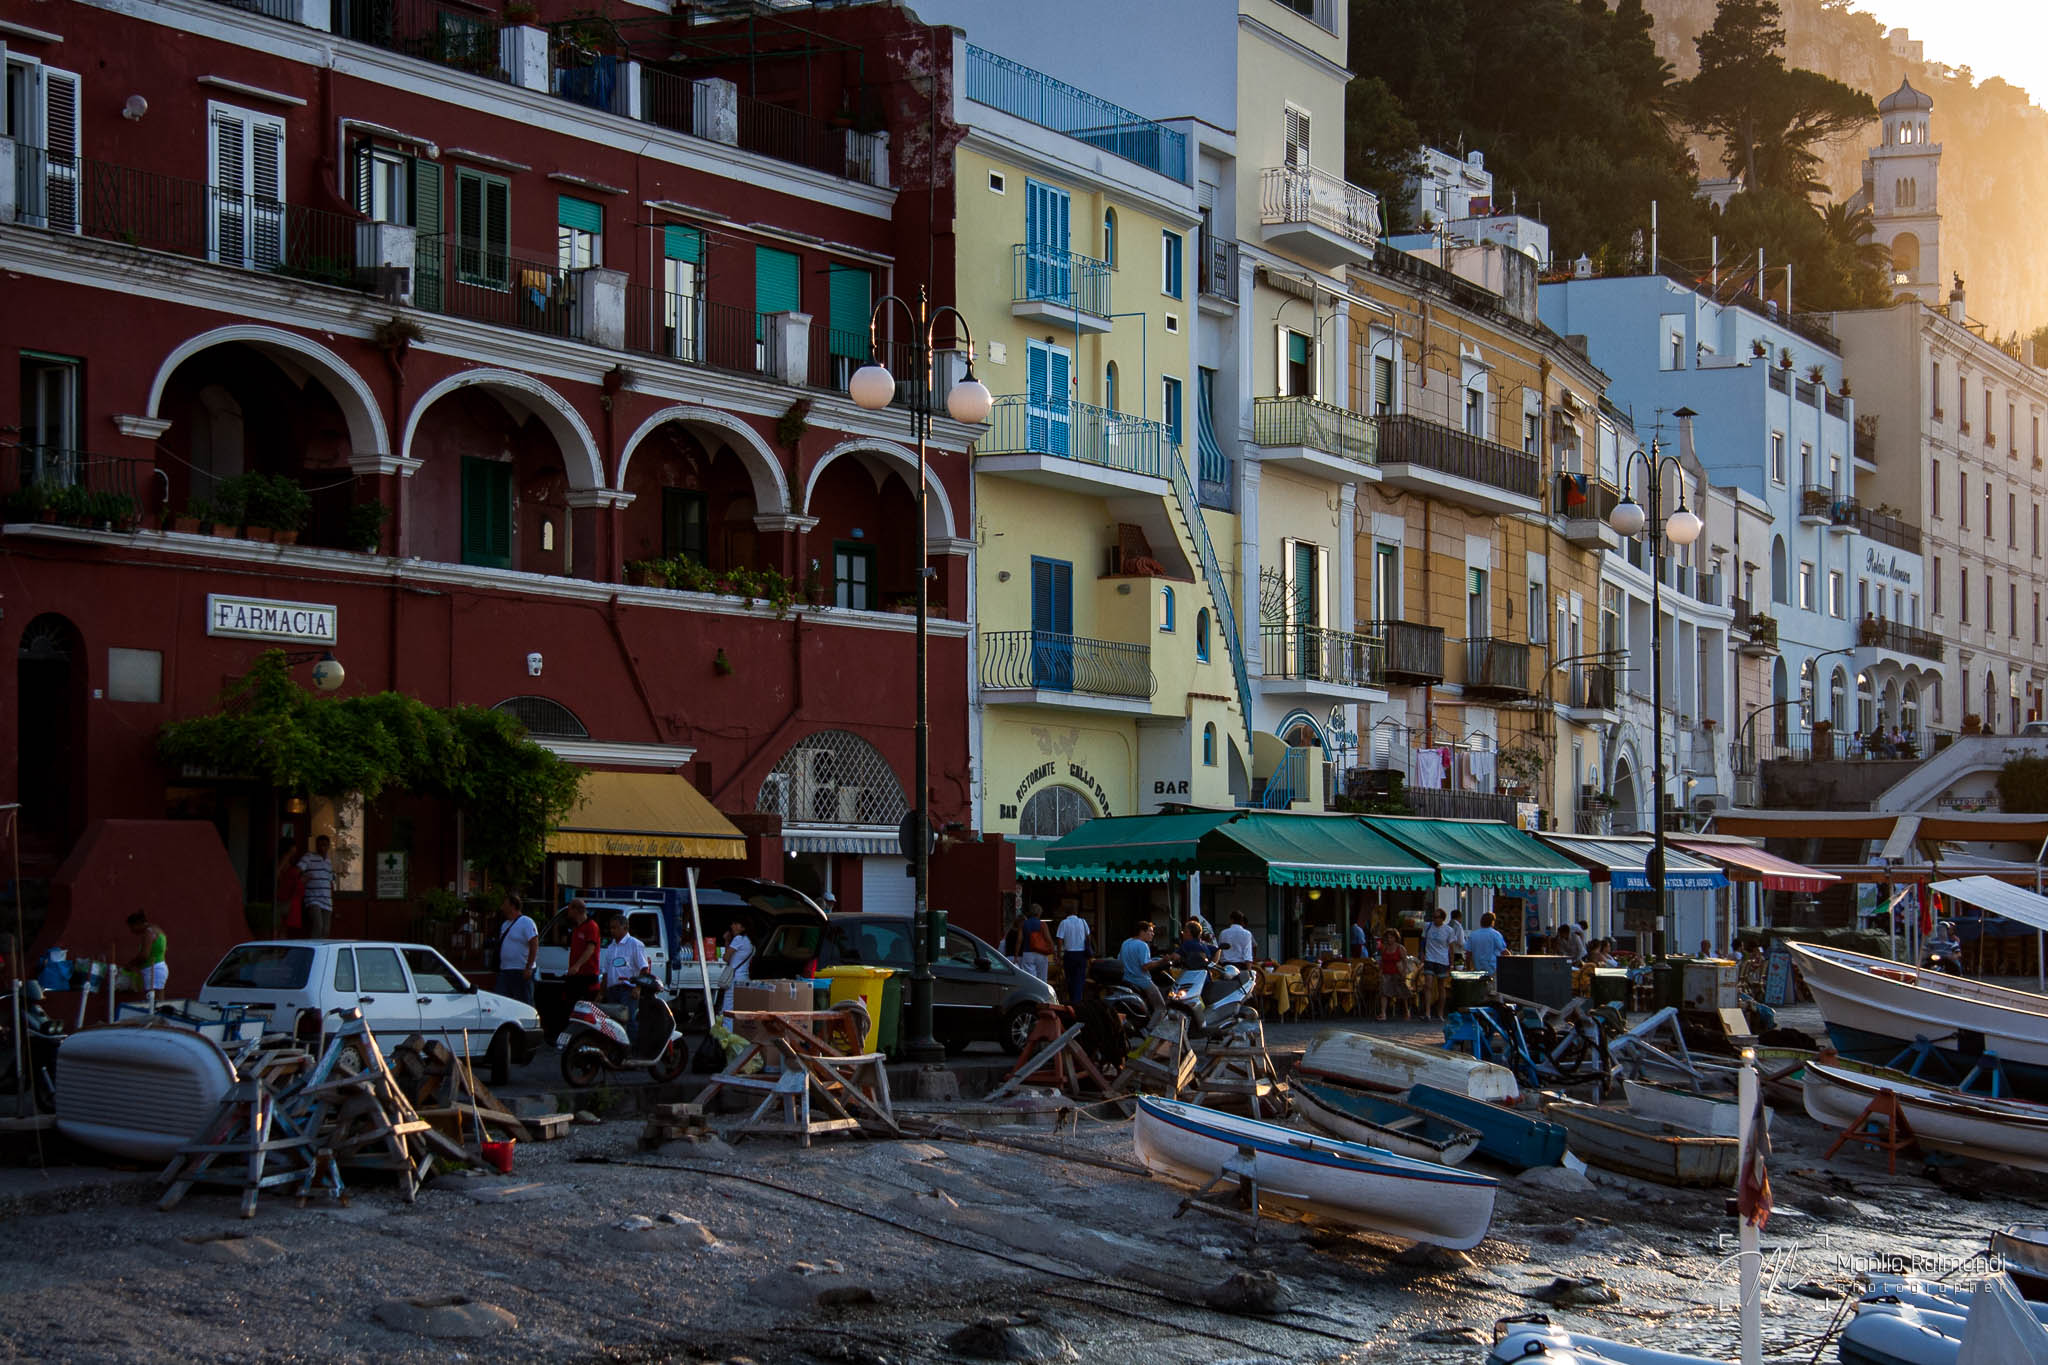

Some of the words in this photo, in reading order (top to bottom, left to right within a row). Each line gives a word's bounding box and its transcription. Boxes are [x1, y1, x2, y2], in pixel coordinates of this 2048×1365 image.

[219, 604, 327, 635] FARMACIA
[1000, 804, 1017, 819] BAR
[1016, 761, 1056, 803] RISTORANTE
[1154, 781, 1189, 794] BAR
[1293, 871, 1354, 884] RISTORANTE
[1355, 873, 1384, 885] GALLO
[1480, 873, 1506, 883] SNACK
[1509, 874, 1524, 884] BAR
